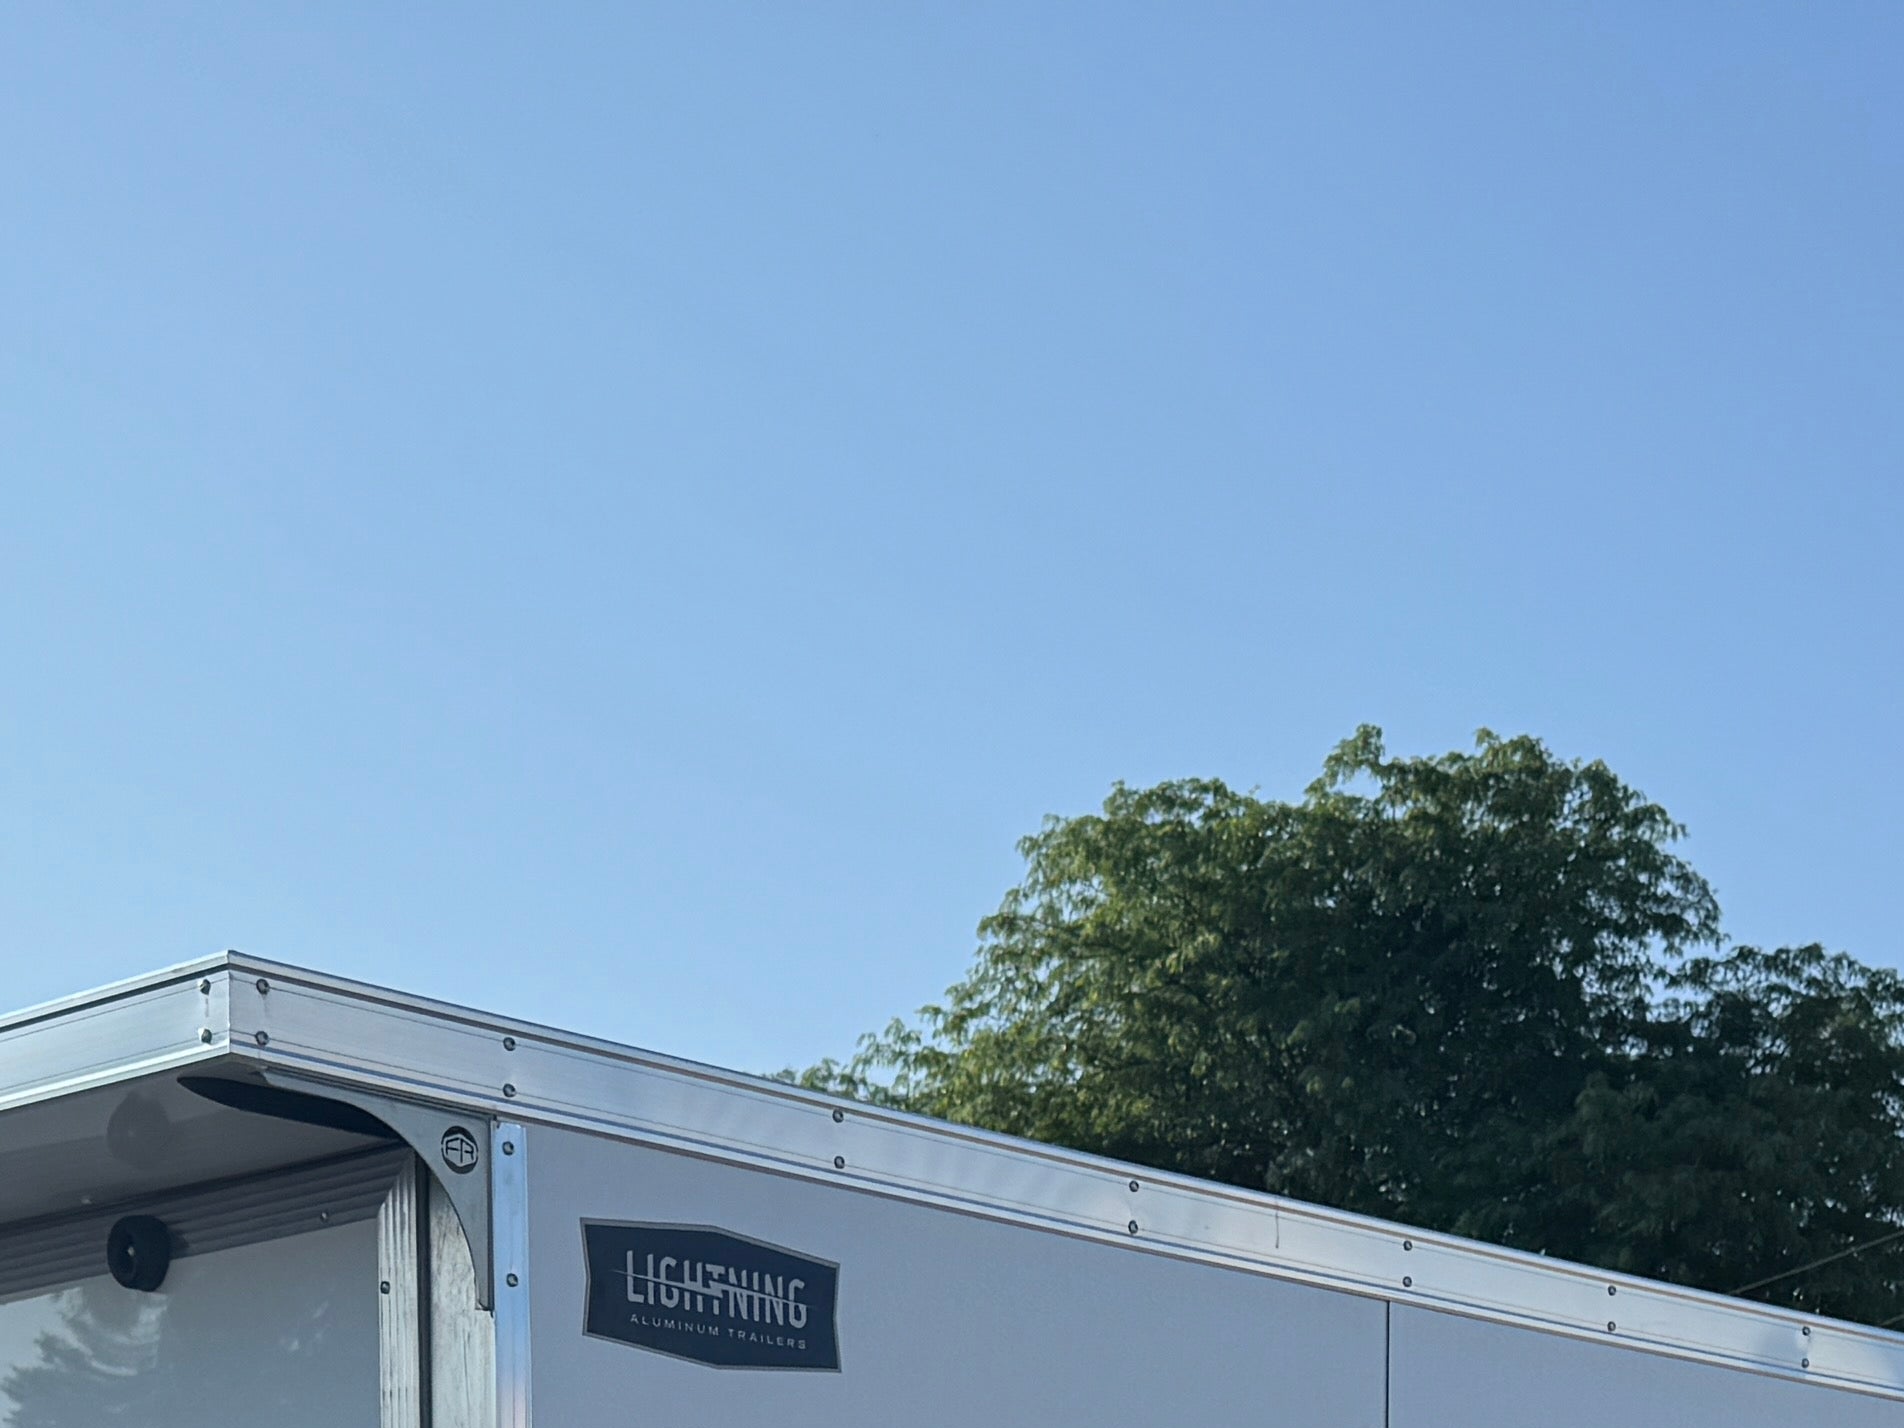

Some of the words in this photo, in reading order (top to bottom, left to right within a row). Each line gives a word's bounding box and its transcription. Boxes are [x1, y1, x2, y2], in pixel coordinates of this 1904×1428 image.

[625, 1250, 808, 1328] LIGHTNING
[629, 1313, 720, 1337] ALUMINUM
[728, 1329, 807, 1350] TRAILERS
